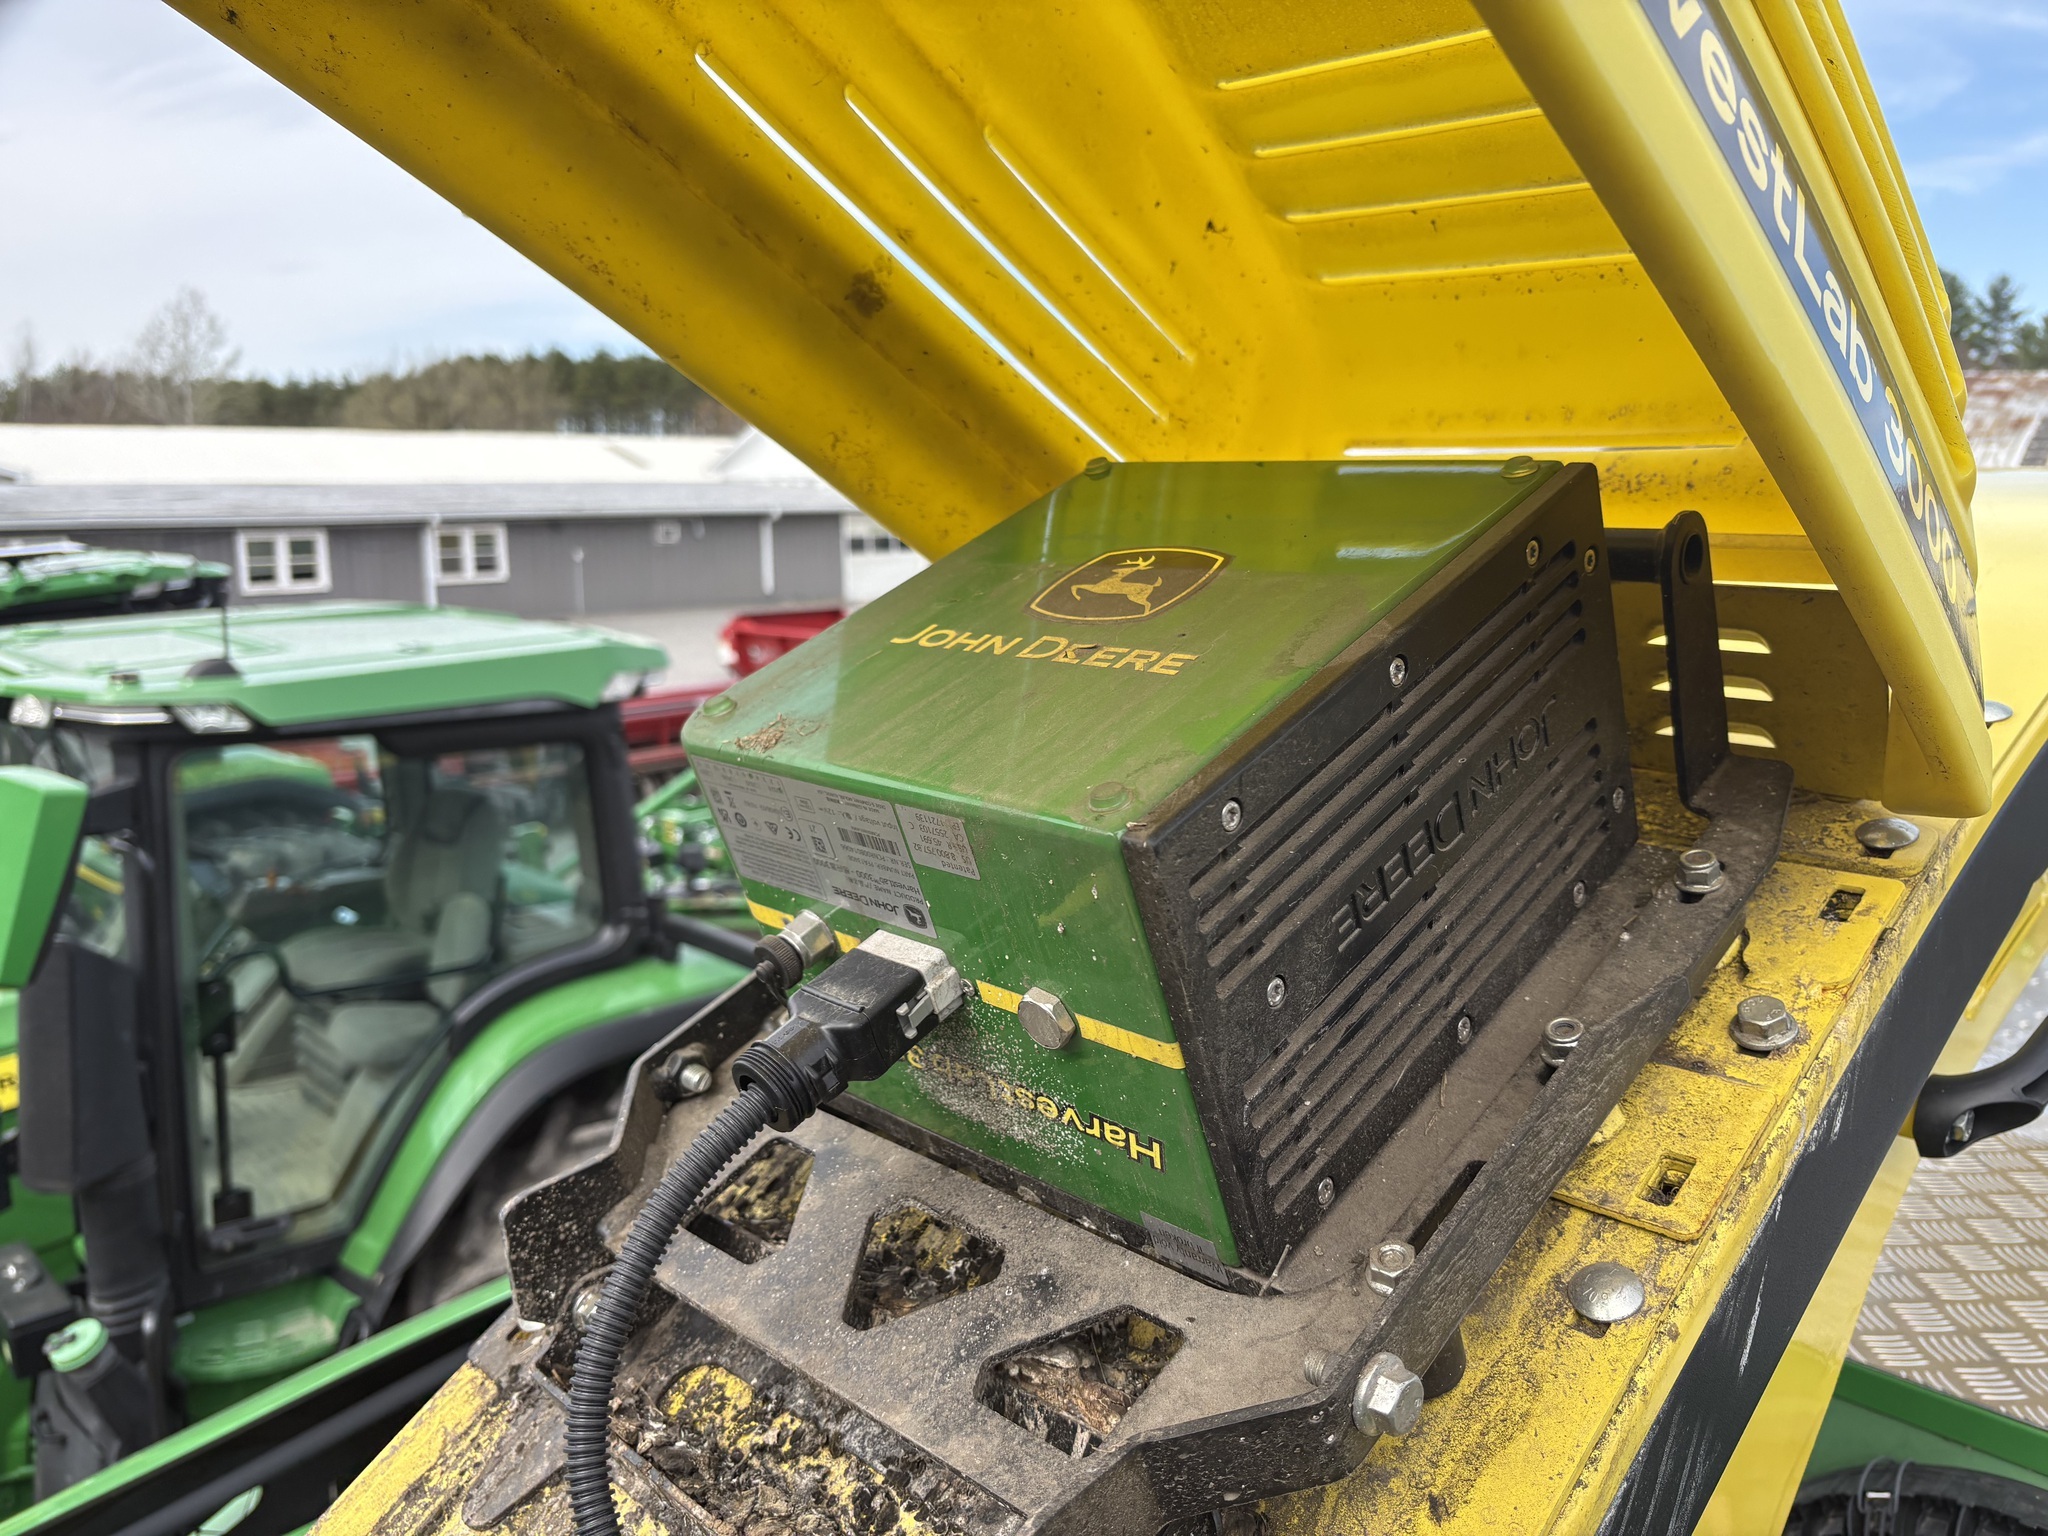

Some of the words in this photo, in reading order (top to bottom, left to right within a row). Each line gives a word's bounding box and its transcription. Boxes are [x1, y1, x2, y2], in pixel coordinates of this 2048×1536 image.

[1884, 386, 1957, 604] 3000
[889, 623, 1023, 656] JOHN
[1015, 635, 1199, 676] DEERE
[1468, 694, 1557, 817] JOHN
[856, 813, 881, 827] voltage
[879, 819, 899, 832] Input
[907, 820, 915, 830] C
[913, 811, 944, 827] 1721139
[949, 820, 961, 830] EP
[917, 822, 949, 839] 2557103
[951, 831, 964, 842] CA
[939, 859, 976, 876] Patented
[960, 854, 972, 865] US
[1331, 790, 1466, 953] DEERE
[831, 885, 869, 906] DEERE
[872, 883, 892, 895] NAME
[891, 889, 924, 905] PRODUCT
[867, 896, 902, 916] JOHN
[1151, 1233, 1174, 1252] void
[1157, 1227, 1195, 1250] broken
[1173, 1242, 1223, 1275] Warranty
